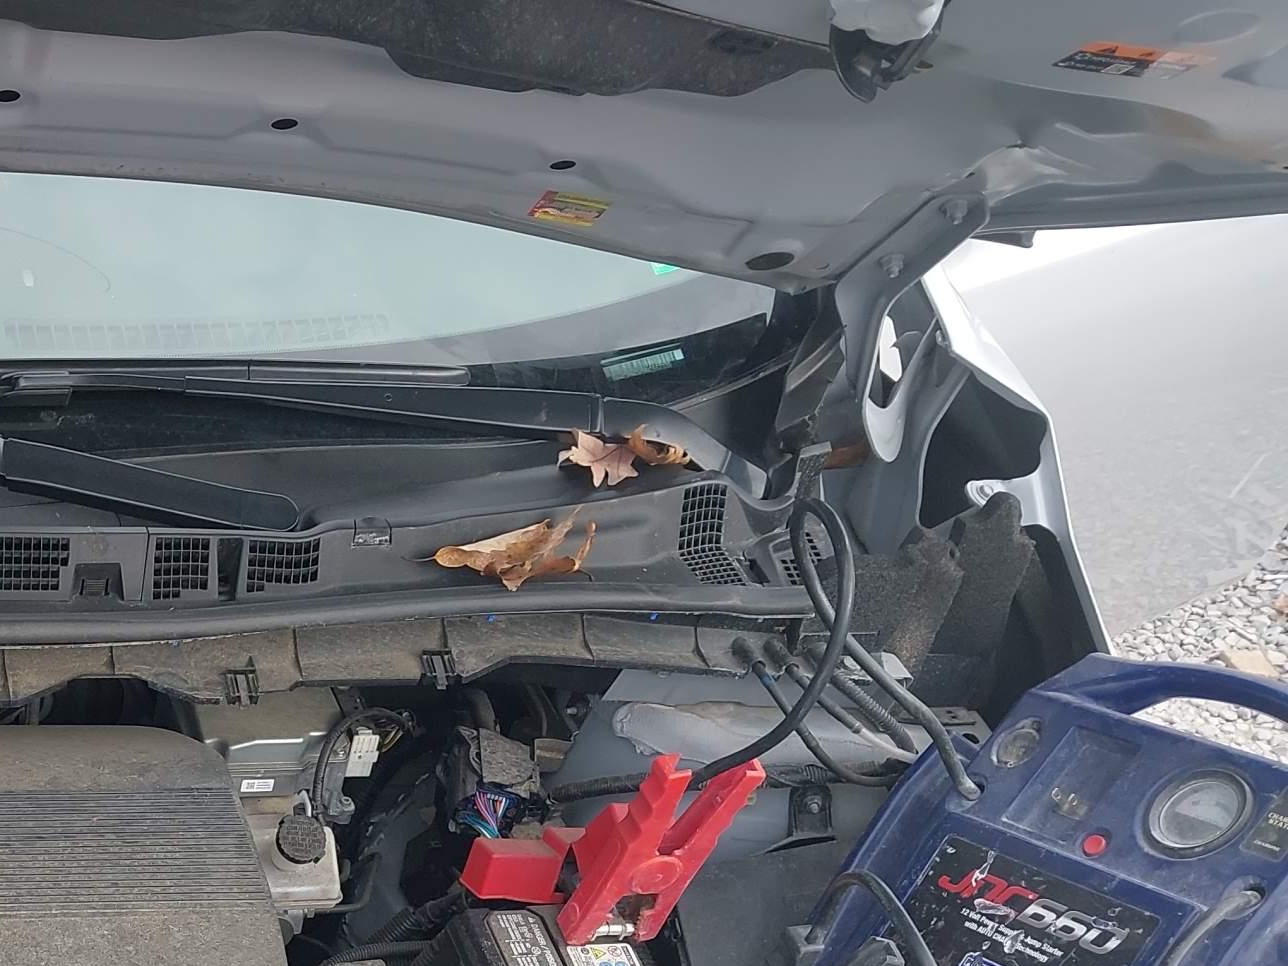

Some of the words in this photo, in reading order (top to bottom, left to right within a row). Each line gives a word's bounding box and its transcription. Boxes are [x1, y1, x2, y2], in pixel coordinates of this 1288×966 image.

[960, 907, 969, 916] 12
[968, 911, 981, 921] Volt
[1024, 935, 1043, 949] Jump
[1042, 943, 1064, 958] Starter
[964, 919, 979, 931] with
[1014, 942, 1050, 964] Technology
